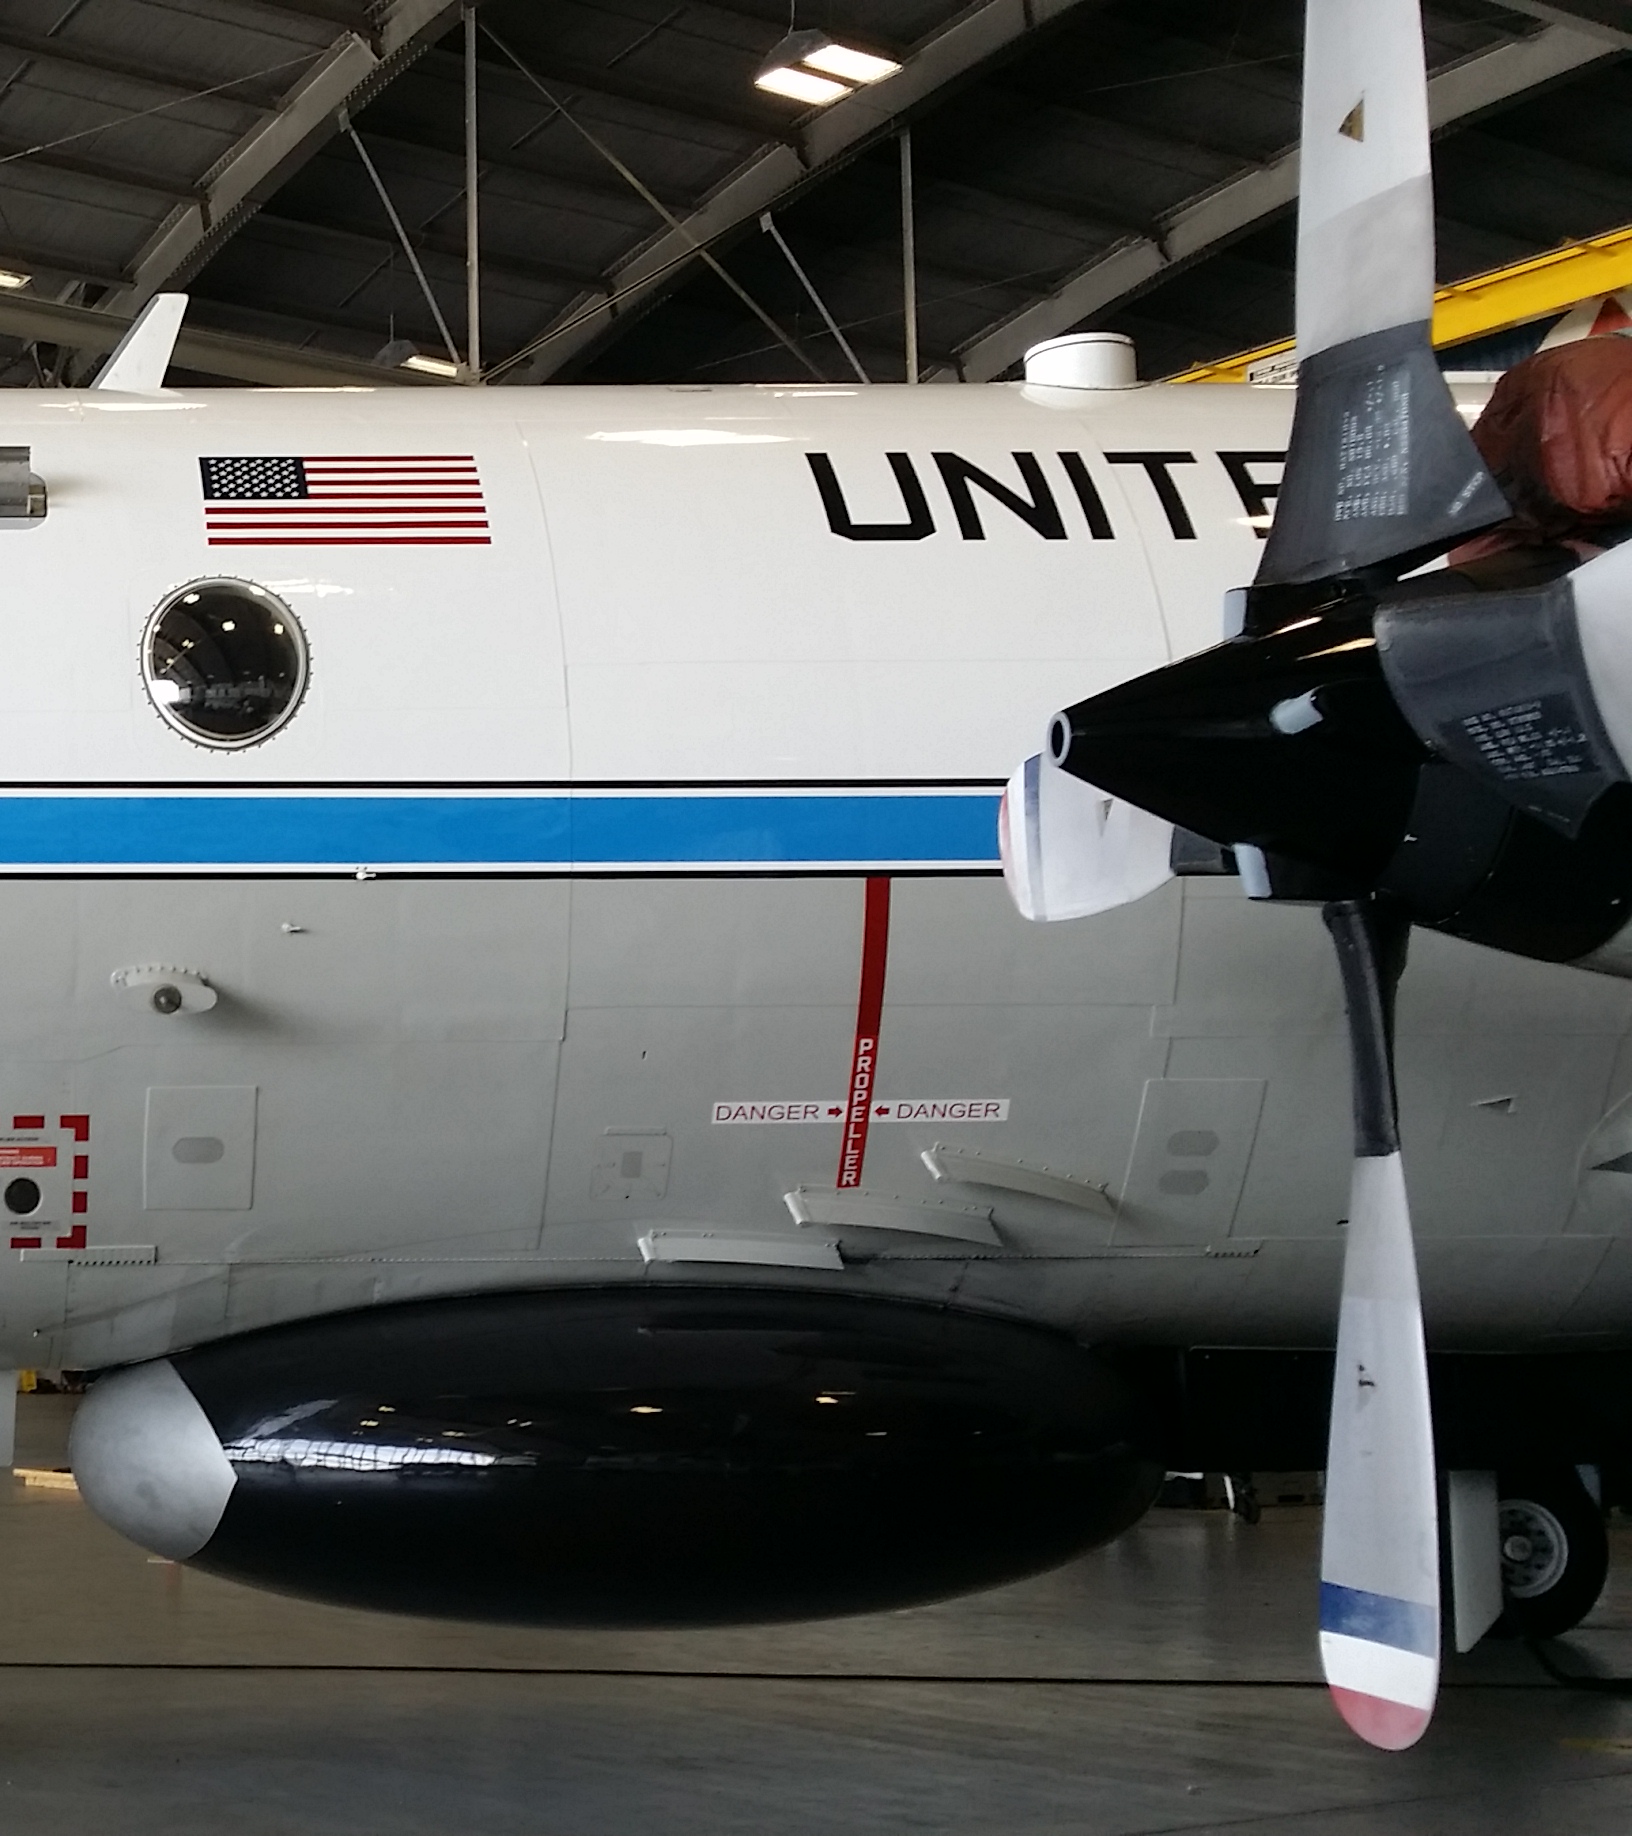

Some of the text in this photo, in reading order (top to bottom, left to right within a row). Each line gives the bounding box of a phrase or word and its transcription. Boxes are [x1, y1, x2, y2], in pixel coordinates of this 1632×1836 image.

[715, 1104, 819, 1121] DANGER
[841, 1038, 874, 1186] PROPELLER
[897, 1102, 1001, 1119] DANGER
